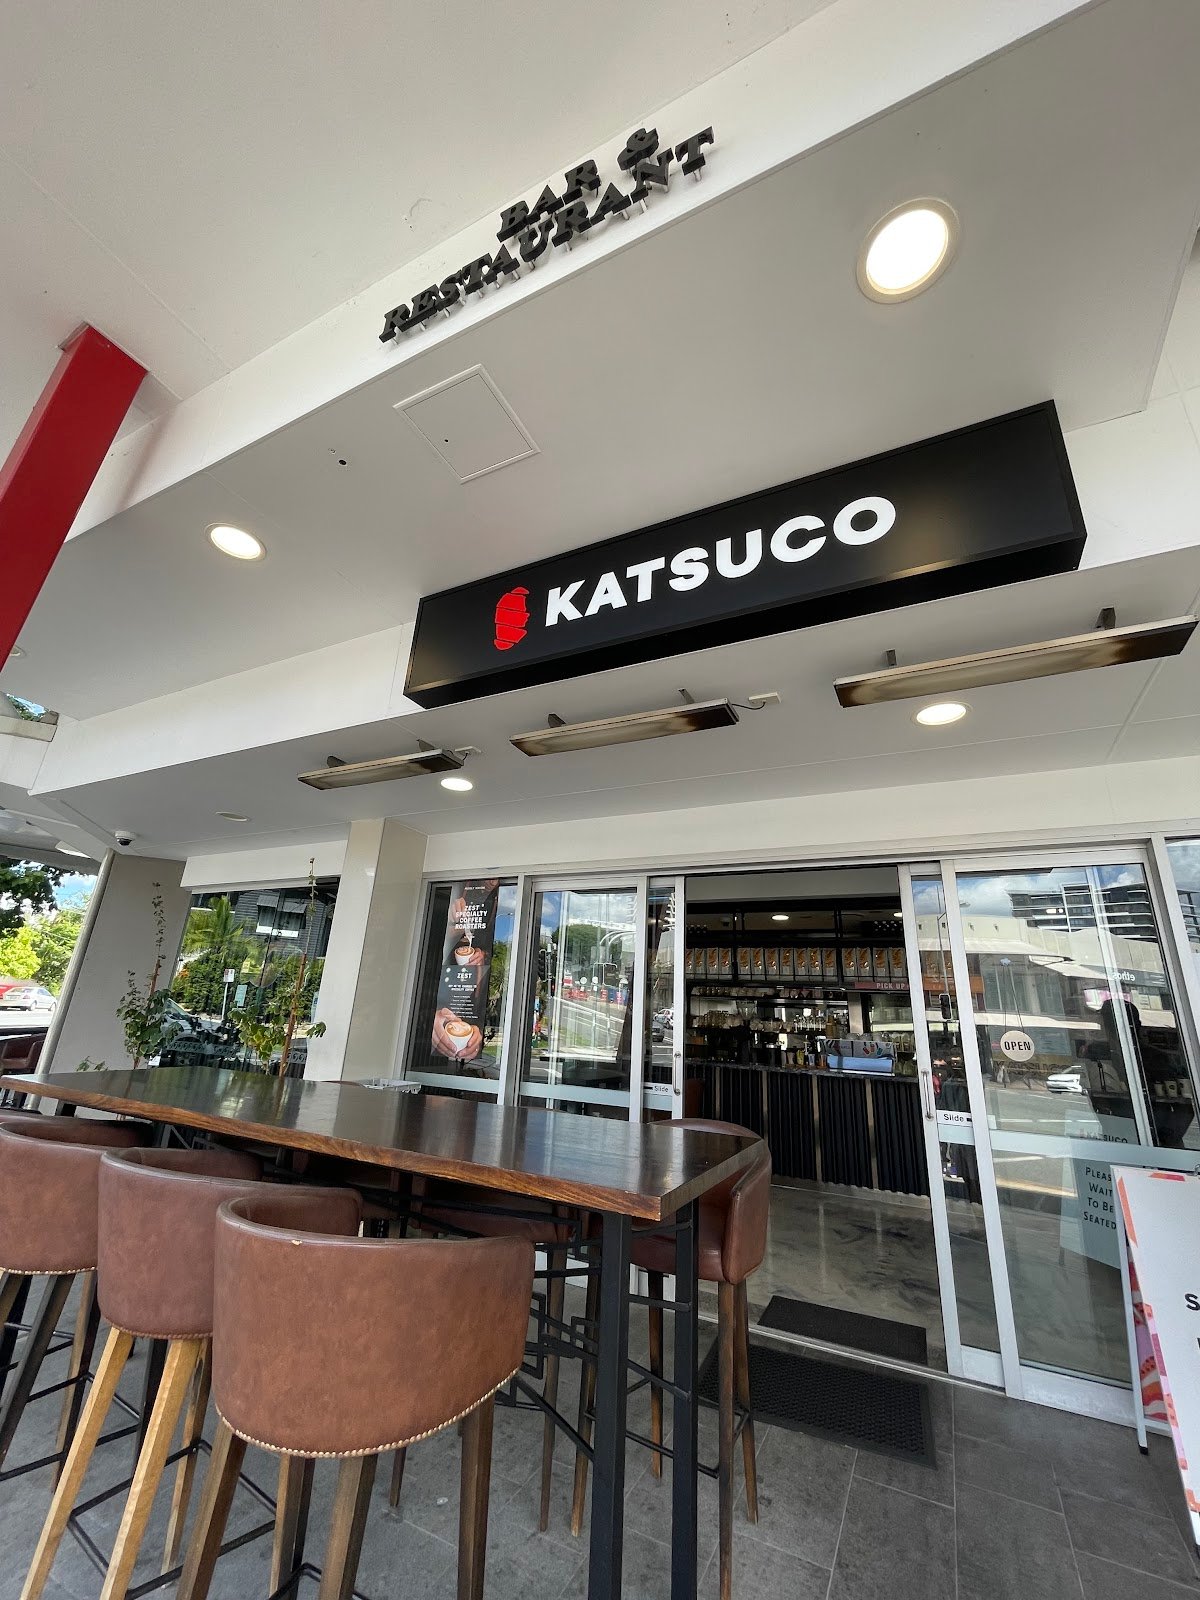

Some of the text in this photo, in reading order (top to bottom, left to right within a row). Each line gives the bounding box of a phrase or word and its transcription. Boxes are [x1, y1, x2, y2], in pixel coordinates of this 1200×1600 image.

[496, 128, 659, 243] BAR &
[379, 126, 714, 343] RESTAURANT
[545, 496, 896, 627] KATSUCO
[455, 910, 488, 918] SPECIALTY
[455, 922, 487, 930] ROASTERS
[1004, 1041, 1032, 1051] OPEN
[943, 1113, 965, 1122] Slide
[1085, 1166, 1112, 1182] PLEAS
[1083, 1211, 1117, 1230] SEATED
